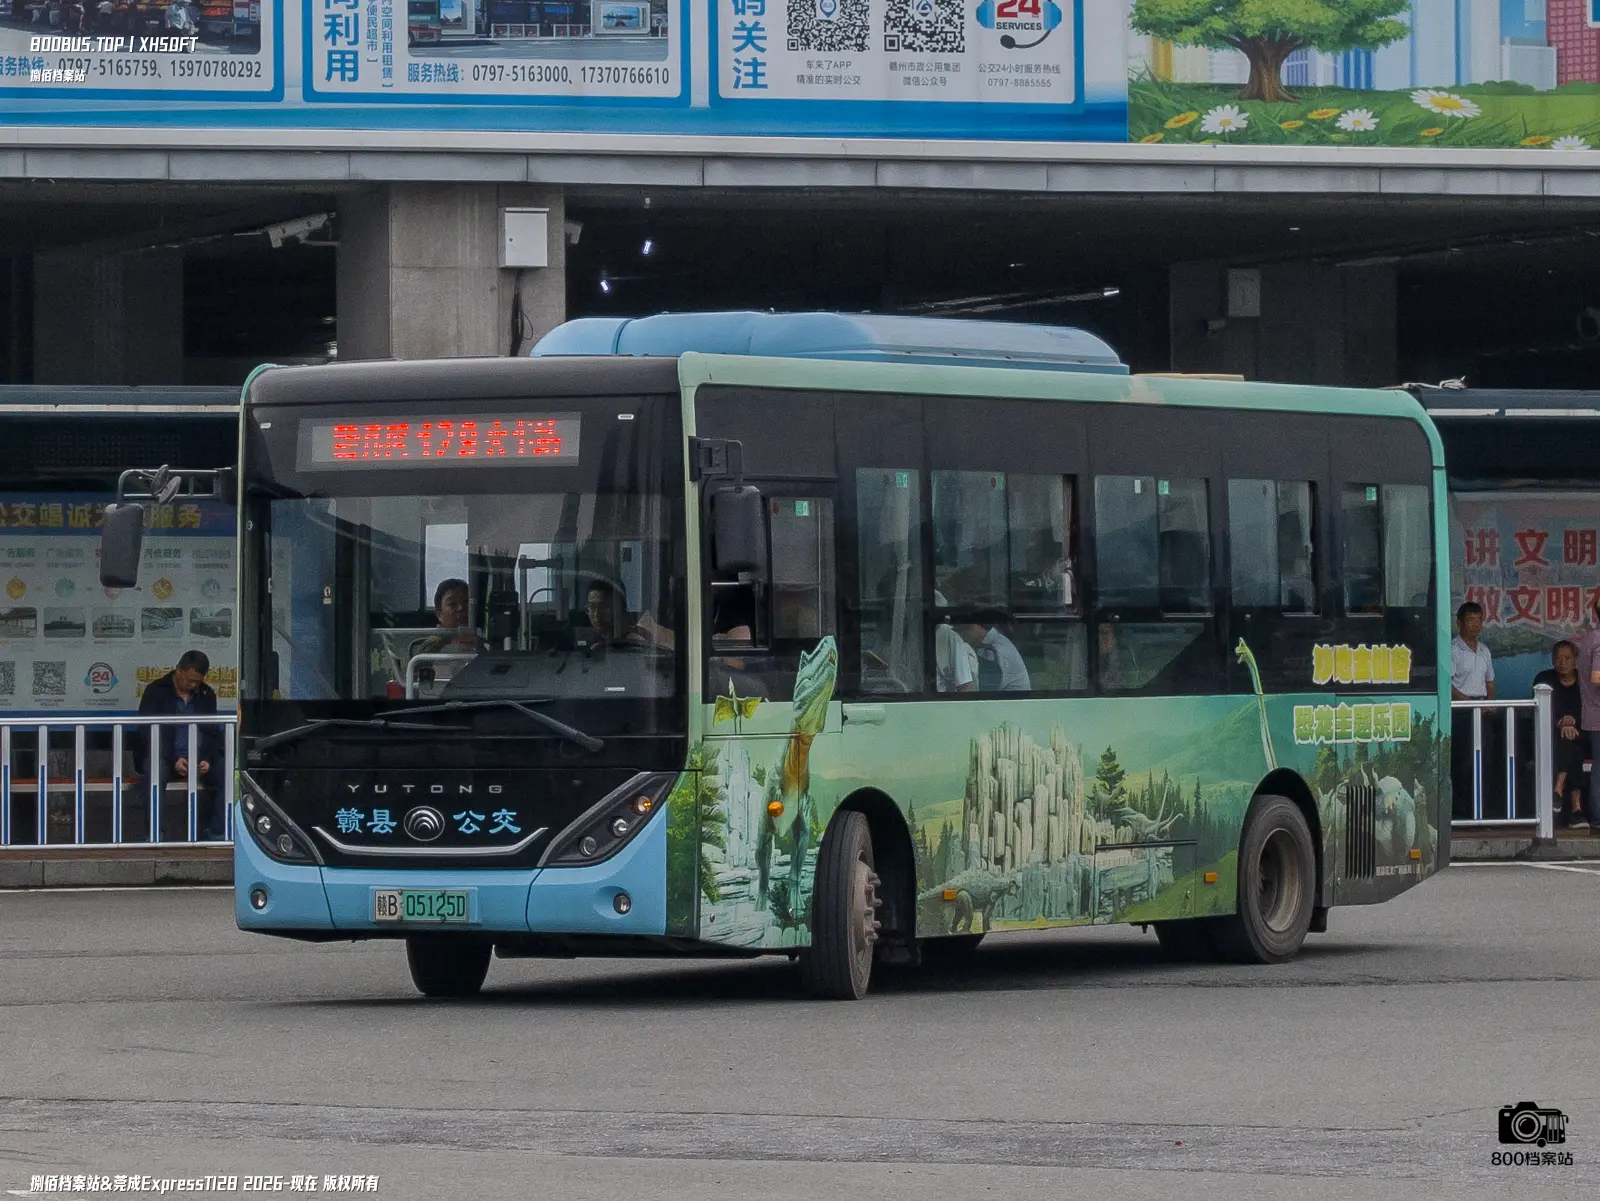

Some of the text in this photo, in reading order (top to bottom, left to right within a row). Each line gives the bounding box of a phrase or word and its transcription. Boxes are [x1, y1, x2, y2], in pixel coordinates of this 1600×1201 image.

[996, 22, 1042, 31] SERVICES
[324, 0, 360, 82] 利用
[806, 60, 852, 71] 车来了APP
[978, 63, 1061, 75] 公交24小时服务热线
[796, 74, 862, 86] 精准的实时公交
[1464, 528, 1598, 567] 讲文明
[92, 671, 110, 682] 24
[348, 784, 503, 793] YUTONG
[335, 808, 522, 835] 赣县 公交
